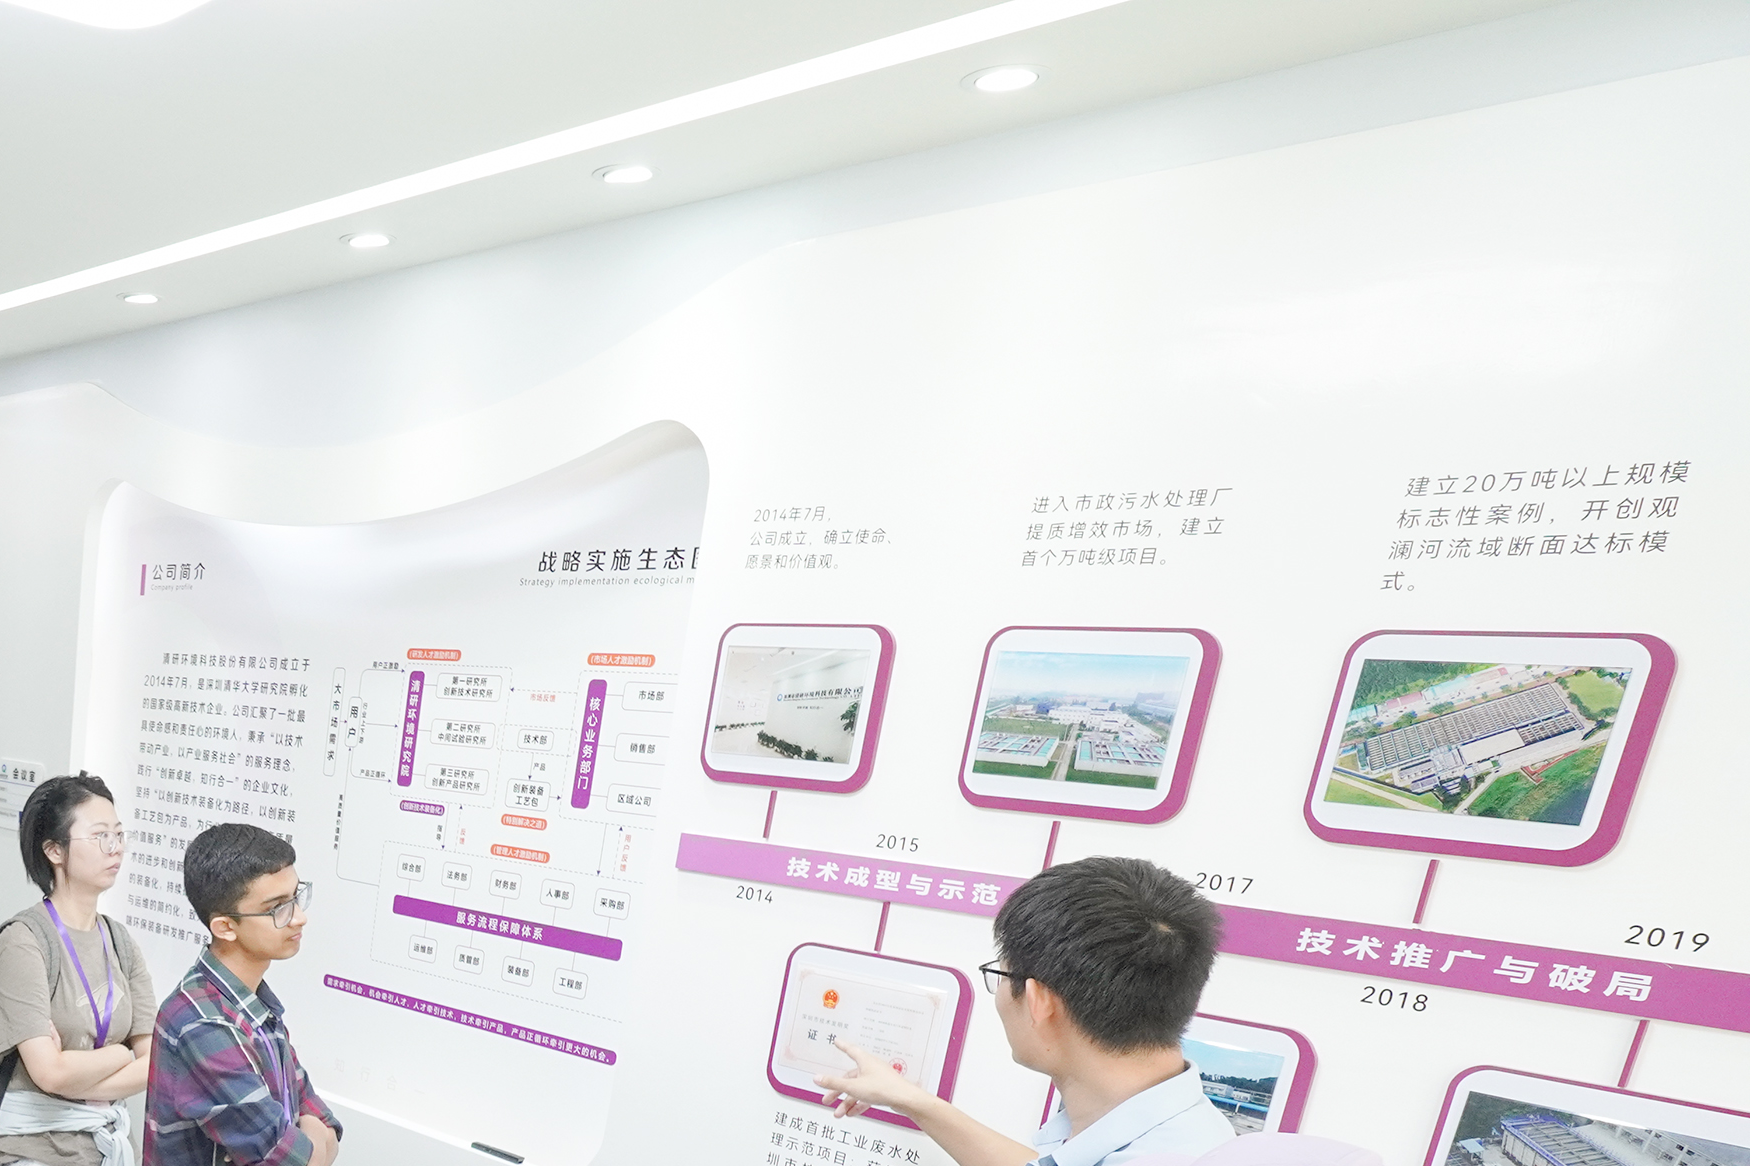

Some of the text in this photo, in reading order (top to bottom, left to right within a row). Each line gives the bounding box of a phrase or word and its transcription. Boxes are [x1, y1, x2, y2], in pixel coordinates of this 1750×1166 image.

[1404, 459, 1692, 499] 建立20万吨以上规模
[1031, 487, 1234, 515] 进入市政污水处理厂
[1396, 495, 1680, 530] 标志性案例，开创观
[1025, 515, 1225, 542] 提质增效市场，建立
[1387, 530, 1670, 561] 澜河流域断面达标模
[1020, 545, 1170, 569] 首个万吨级项目。
[152, 563, 206, 581] 公司简介
[151, 583, 193, 592] Company profile
[519, 577, 555, 588] Strategy
[558, 577, 630, 588] implementation
[634, 576, 683, 587] ecological
[163, 653, 310, 672] 清研环境科技股份有限公司成立于
[452, 676, 488, 687] 第一研究所
[443, 687, 493, 699] 创新技术研究所
[638, 690, 665, 702] 市场部
[327, 683, 342, 761] 大市场需求
[347, 705, 359, 740] 用户
[400, 680, 422, 778] 清研环境研究院
[446, 722, 481, 734] 第二研究所
[523, 734, 548, 745] 技术部
[577, 697, 602, 790] 核心业务部门
[630, 743, 656, 755] 销售部
[13, 768, 36, 783] 会议室
[440, 767, 475, 780] 第三研究所
[432, 777, 480, 792] 创新产品研究所
[513, 784, 545, 796] 创新装备
[515, 795, 539, 807] 工艺包
[617, 794, 652, 807] 区域公司
[134, 808, 221, 831] 备工艺包为产品，为行
[876, 833, 920, 853] 2015
[494, 879, 517, 891] 财务部
[786, 854, 1002, 907] 技术成型与示范
[1194, 871, 1255, 895] 2017
[546, 888, 570, 901] 人事部
[600, 897, 625, 911] 采购部
[736, 884, 774, 905] 2014
[456, 911, 544, 941] 服务流程保障体系
[1624, 924, 1711, 953] 2019
[507, 965, 530, 978] 装备部
[1296, 928, 1654, 1002] 技术推广与破局
[558, 976, 583, 991] 工程部
[1360, 986, 1430, 1013] 2018
[774, 1110, 921, 1166] 建成首批工业废水处
